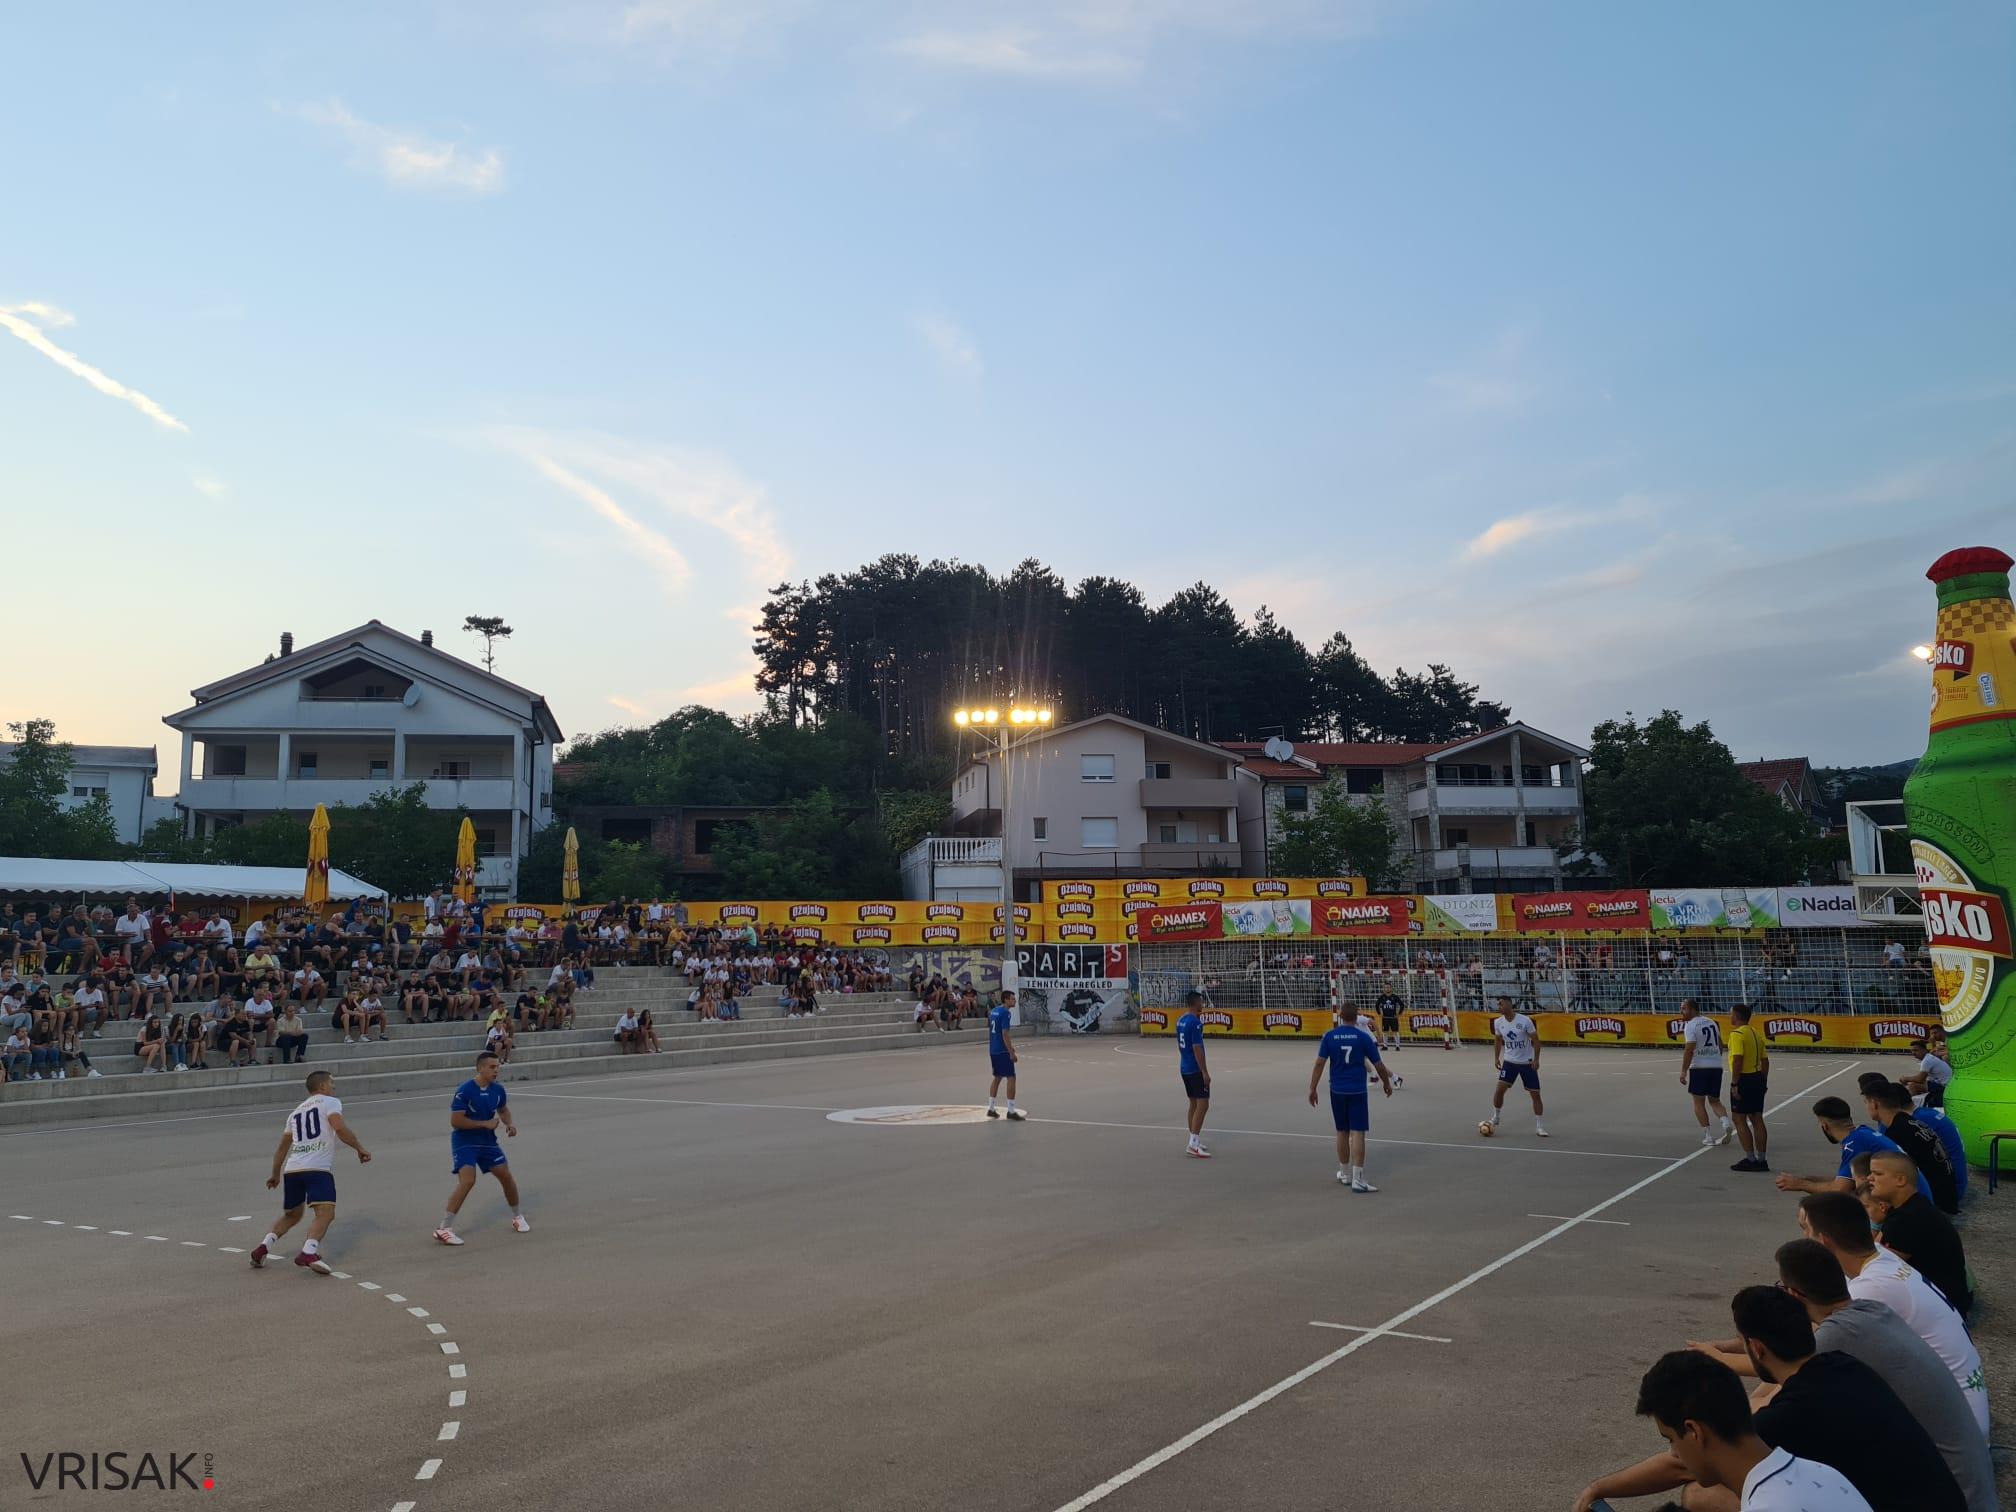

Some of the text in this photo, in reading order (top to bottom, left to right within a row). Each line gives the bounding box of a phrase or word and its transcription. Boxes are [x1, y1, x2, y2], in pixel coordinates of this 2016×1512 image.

[1060, 882, 1092, 895] Ožujsko
[1126, 881, 1157, 893] Ožujsko
[1191, 881, 1222, 893] Ožujsko
[1255, 880, 1287, 892] Ožujsko
[1319, 880, 1351, 892] Ožujsko
[722, 904, 757, 918] Ožujsko
[792, 904, 826, 917] Ožujsko
[861, 904, 894, 917] Ožujsko
[929, 903, 962, 917] Ožujsko
[1060, 901, 1091, 913] Ožujsko
[1443, 900, 1494, 909] DIONIZ
[1534, 902, 1572, 914] NAMEX
[1599, 901, 1639, 912] NAMEX
[1666, 904, 1710, 917] S VRHA
[507, 907, 543, 919] Ožujsko
[1164, 911, 1207, 926] NAMEX
[1341, 905, 1391, 920] NAMEX
[793, 926, 820, 939] žujsko
[856, 927, 889, 940] Ožujsko
[925, 925, 958, 938] Ožujsko
[1062, 923, 1094, 936] Ožujsko
[1017, 944, 1123, 979] PARTS
[1027, 980, 1113, 989] TEHNIČKI PREGLED
[1975, 967, 1986, 993] PIVO
[1200, 1011, 1231, 1026] Ožujsko
[1266, 1011, 1300, 1026] Ožujsko
[1579, 1017, 1622, 1033] Ožujsko
[991, 1020, 996, 1034] 2
[1769, 1018, 1818, 1036] Ožujsko
[1875, 1020, 1926, 1038] Ožujsko
[1179, 1032, 1186, 1049] 5
[1702, 1024, 1718, 1047] 21
[1340, 1045, 1353, 1065] 7
[294, 1107, 321, 1142] 10
